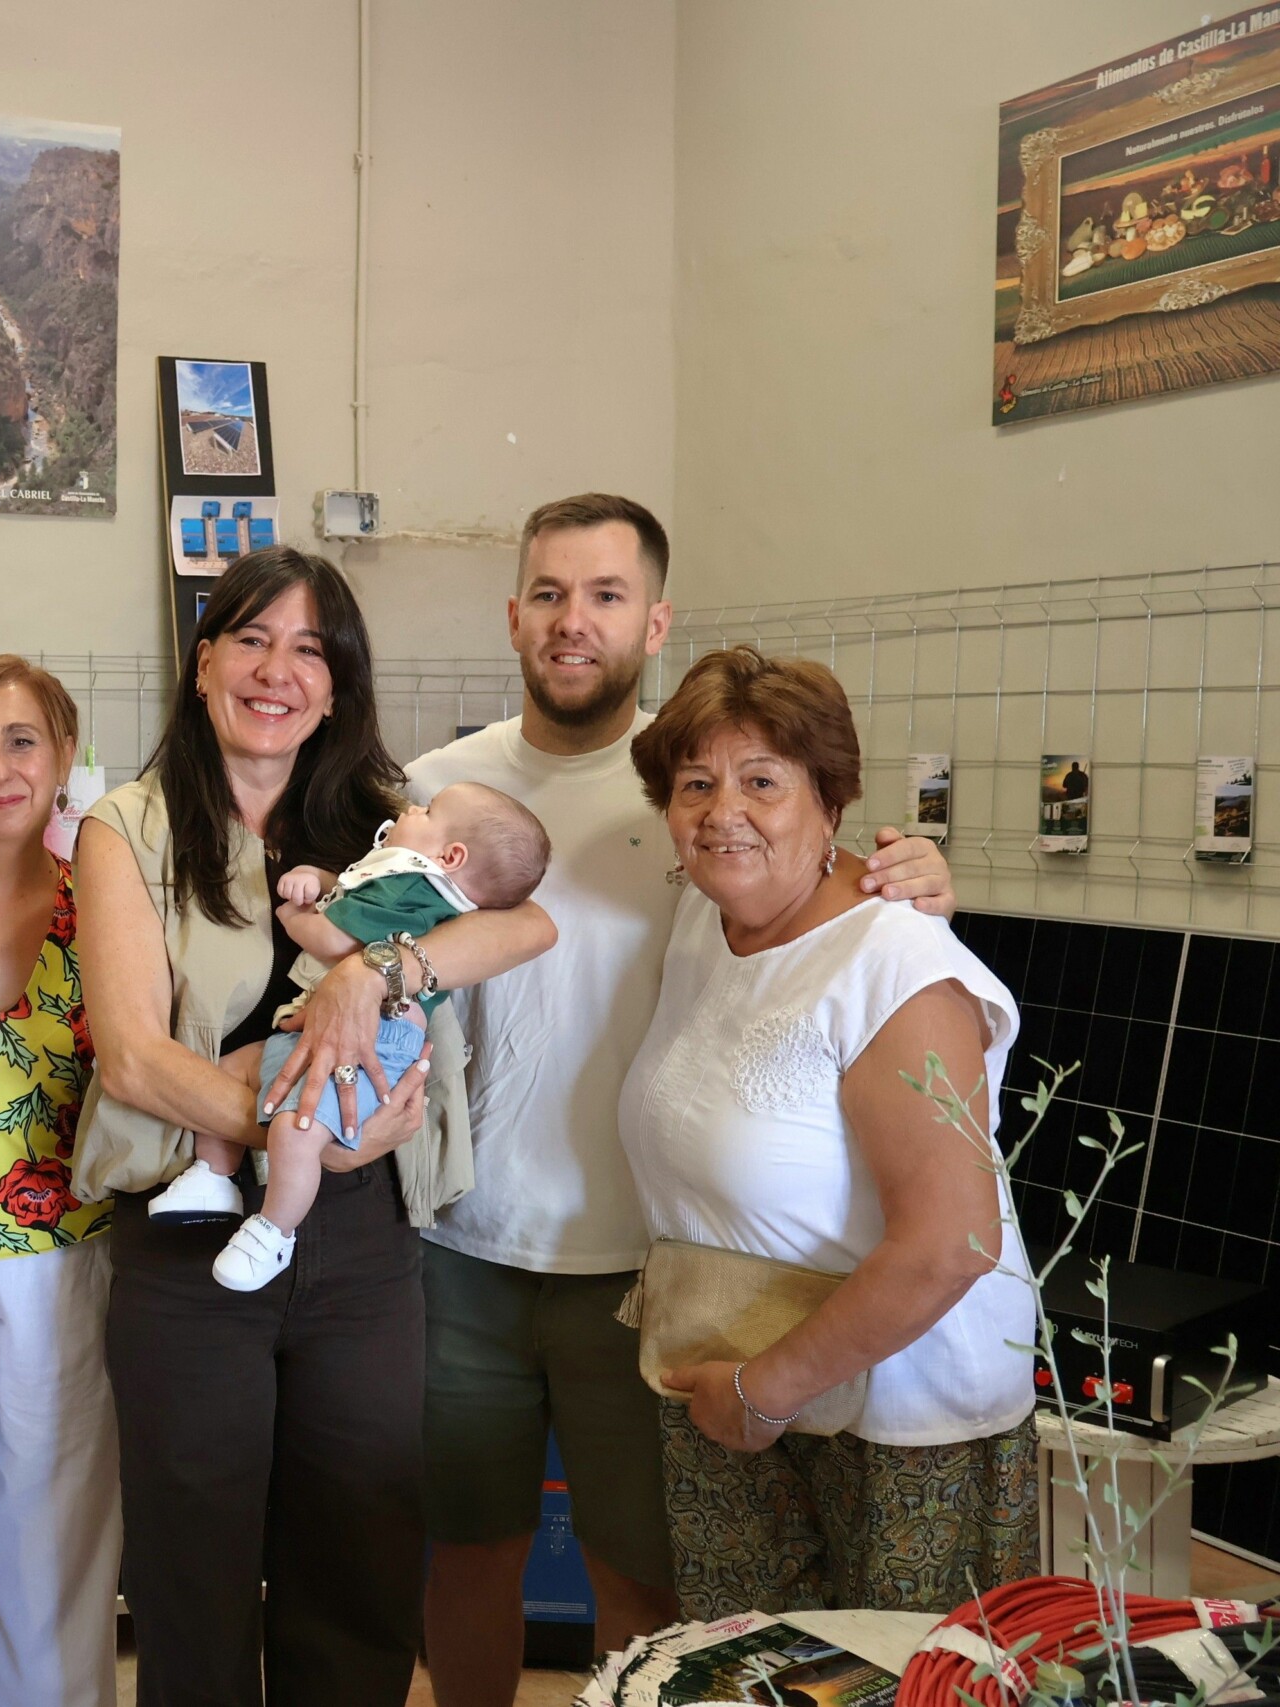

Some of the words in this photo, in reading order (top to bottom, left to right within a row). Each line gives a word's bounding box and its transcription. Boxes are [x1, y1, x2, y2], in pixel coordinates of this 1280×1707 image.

[1096, 55, 1156, 90] Alimentos
[1159, 47, 1175, 66] de
[1177, 20, 1246, 59] Castilla-La
[1125, 133, 1179, 156] Naturalmente
[10, 488, 52, 501] CABRIEL
